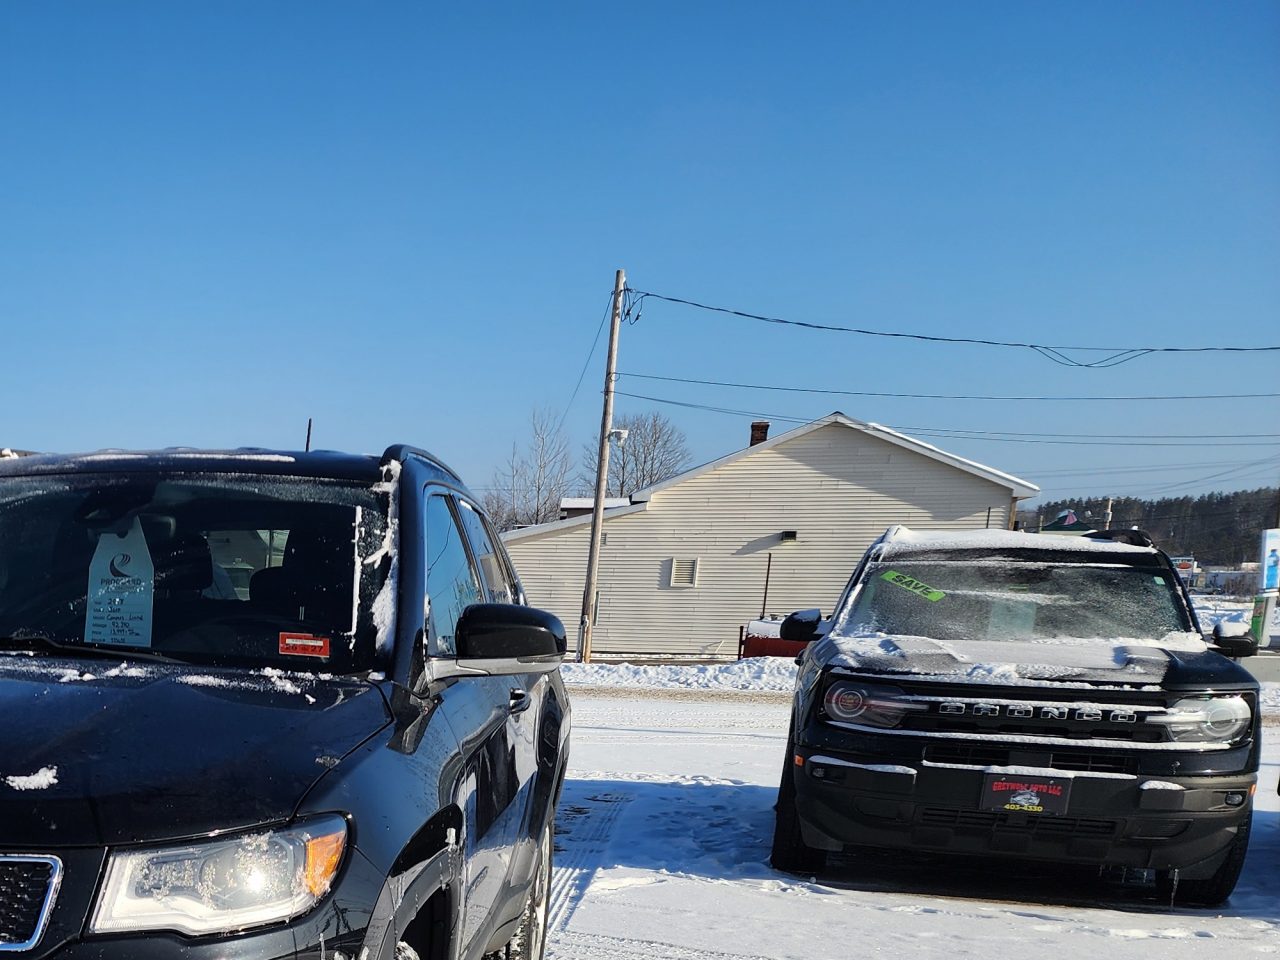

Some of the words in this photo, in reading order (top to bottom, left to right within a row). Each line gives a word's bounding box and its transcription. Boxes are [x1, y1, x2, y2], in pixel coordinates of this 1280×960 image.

[891, 574, 933, 596] SAVE
[939, 702, 1137, 723] BRONCO
[1004, 803, 1043, 812] 403-4330
